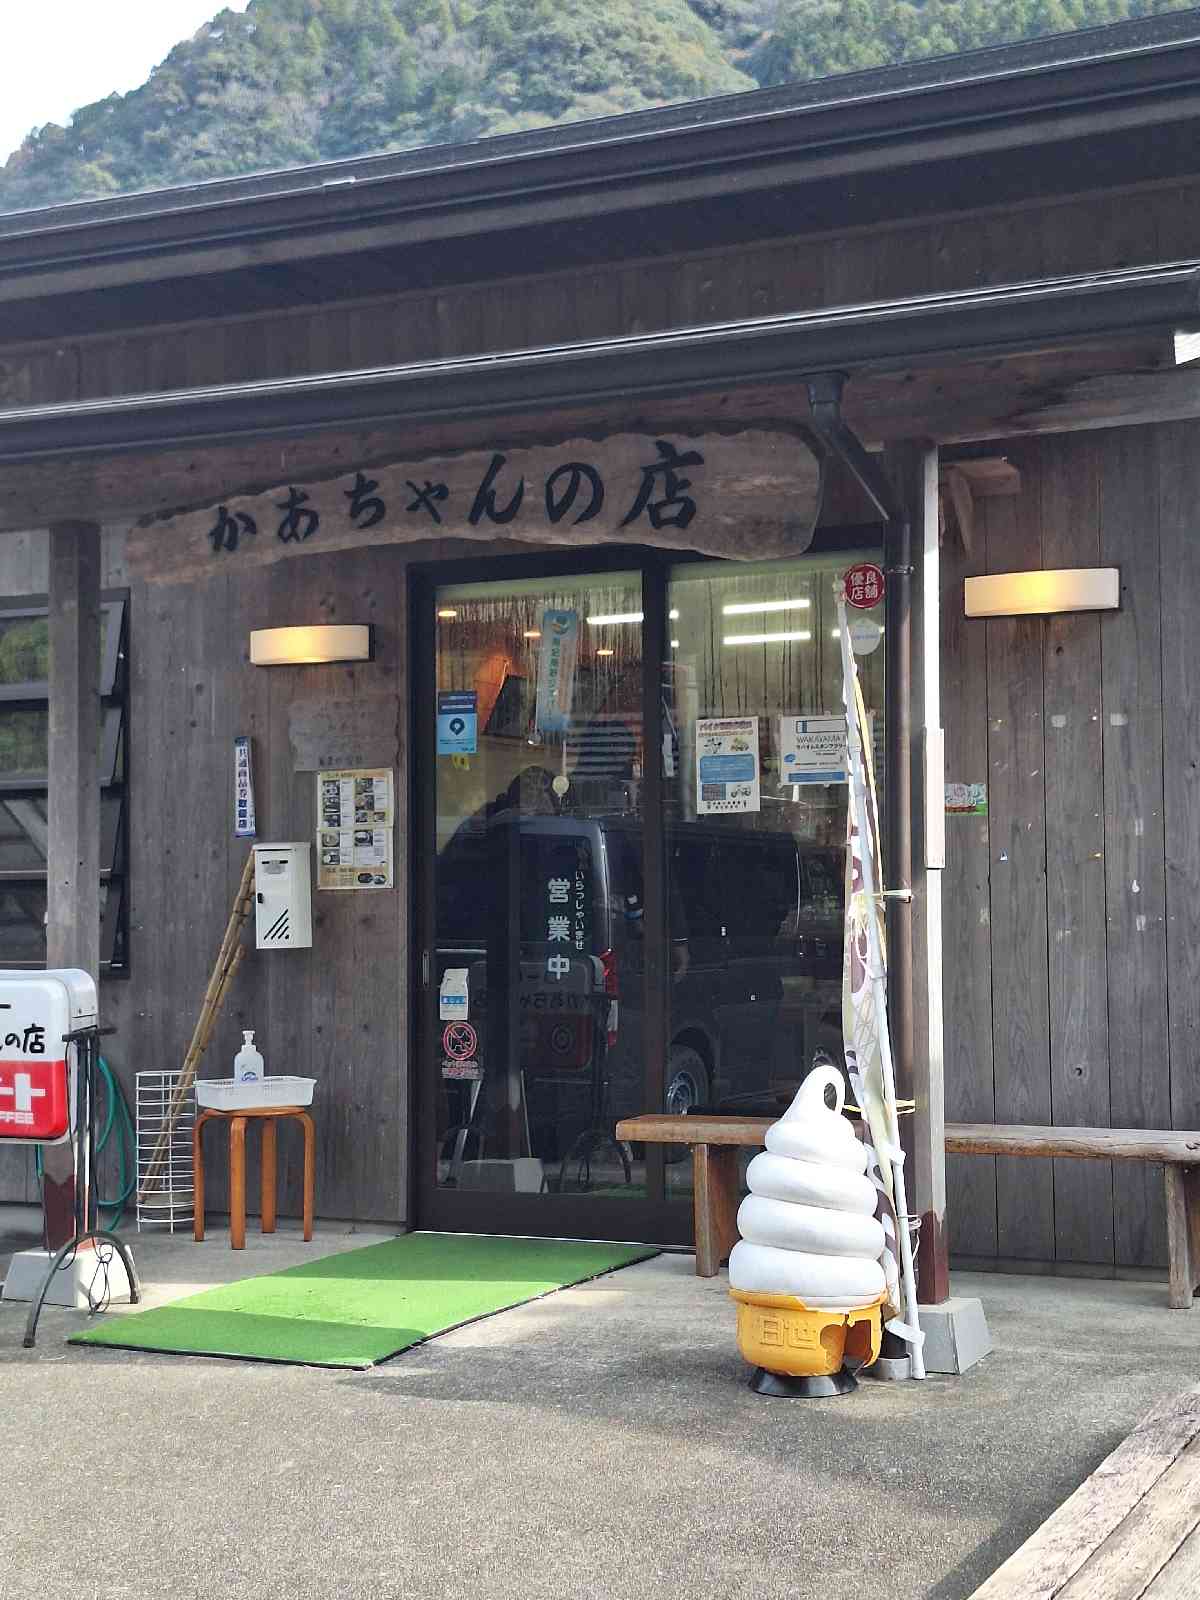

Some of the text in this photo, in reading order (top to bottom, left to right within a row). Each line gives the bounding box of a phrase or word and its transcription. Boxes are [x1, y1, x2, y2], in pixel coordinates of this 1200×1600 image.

[209, 440, 704, 552] かあちゃんの店
[547, 877, 571, 980] 営業中
[575, 870, 585, 950] いらっしゃいませ
[0, 1023, 46, 1054] の店
[760, 1317, 817, 1350] 日世
